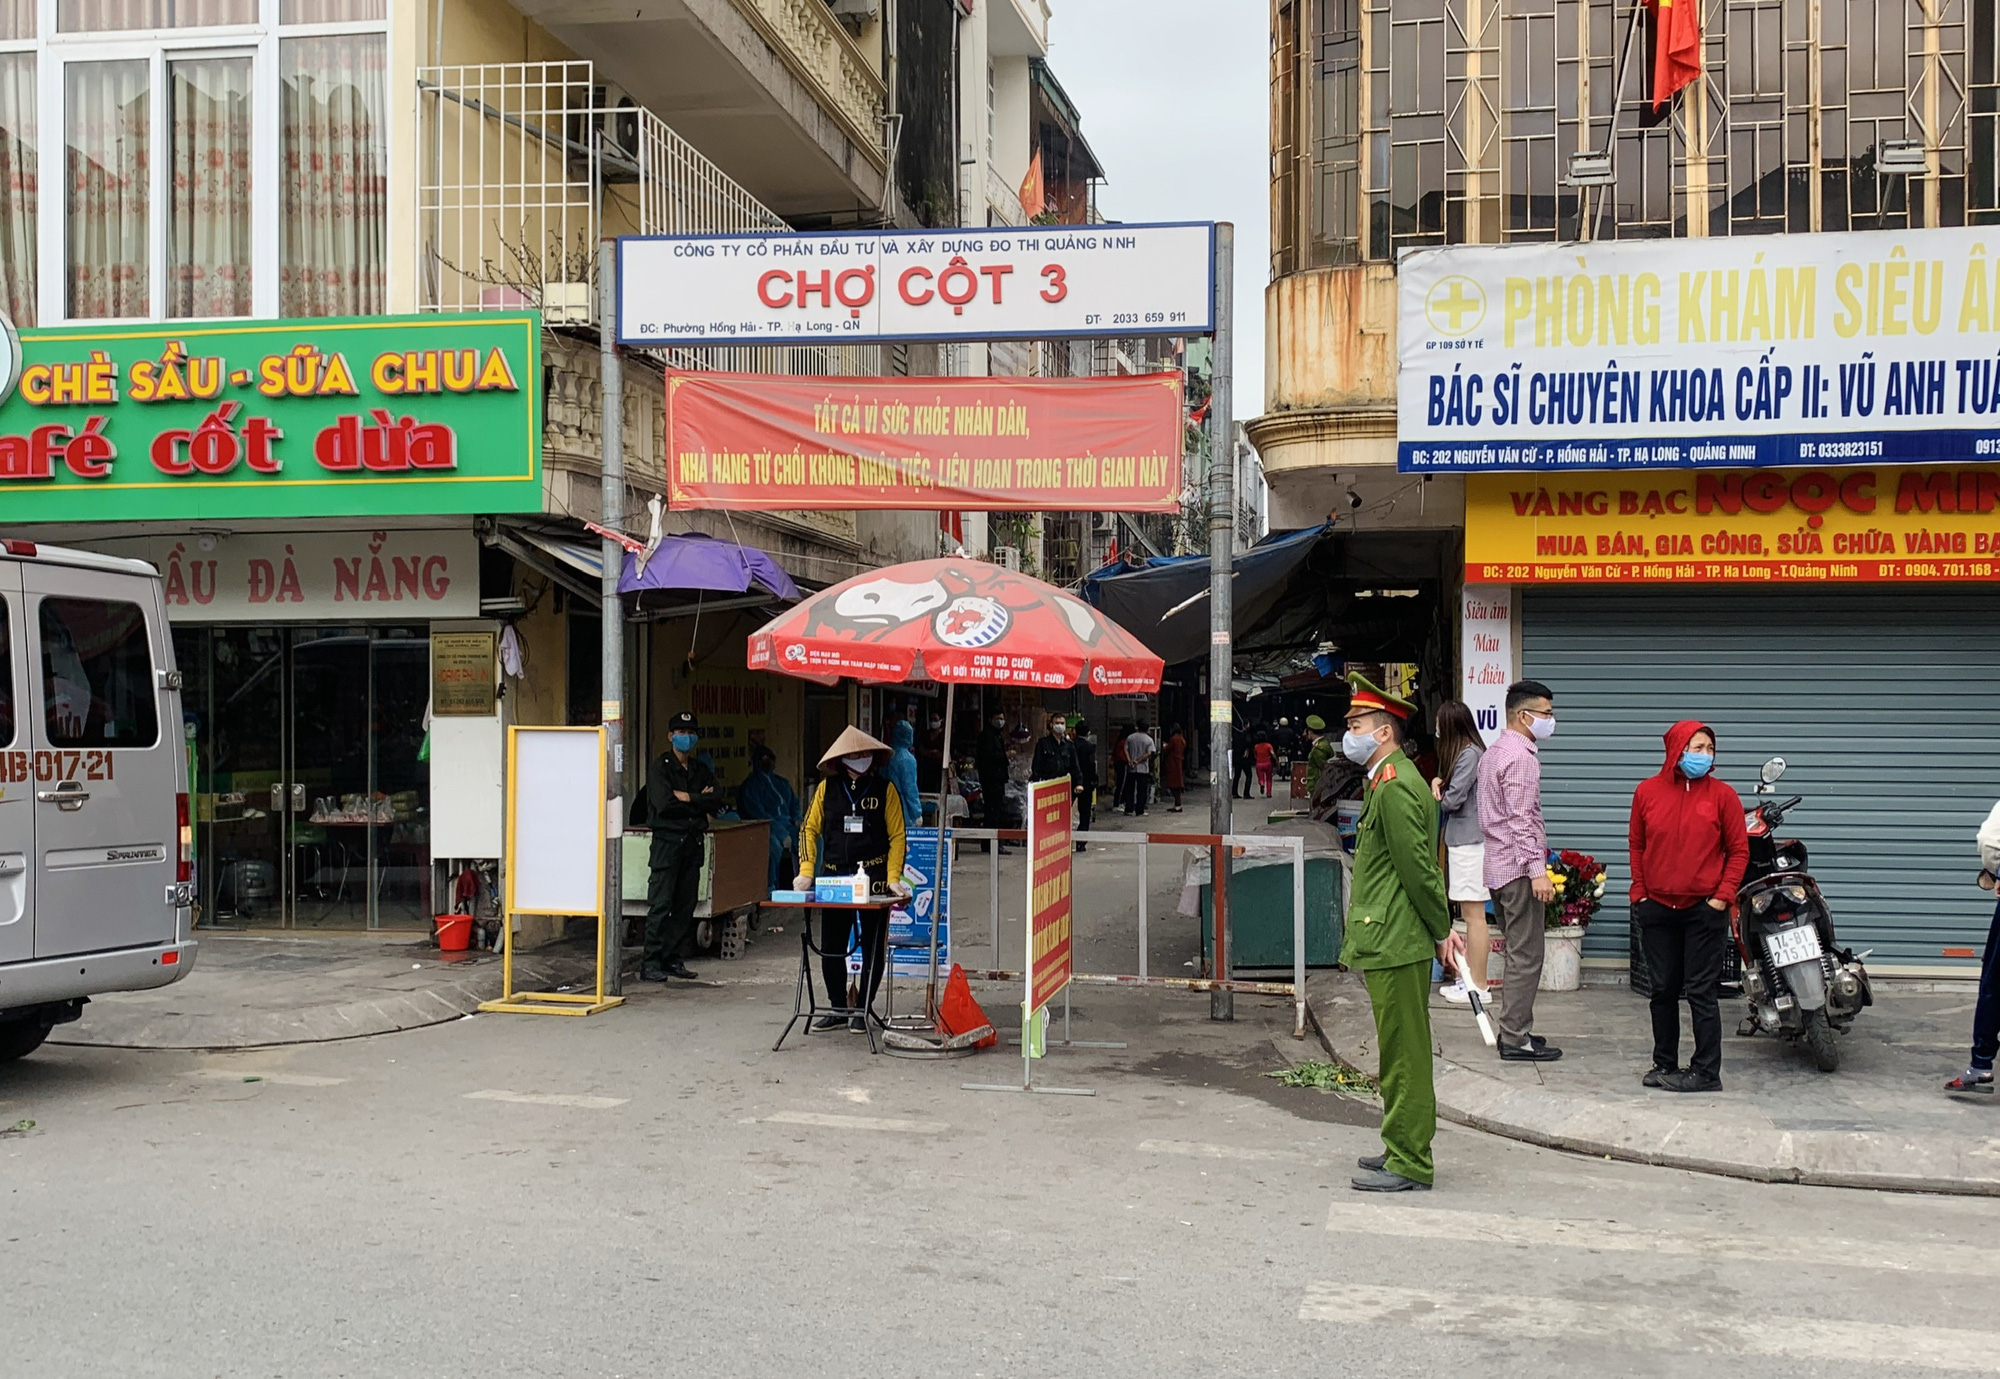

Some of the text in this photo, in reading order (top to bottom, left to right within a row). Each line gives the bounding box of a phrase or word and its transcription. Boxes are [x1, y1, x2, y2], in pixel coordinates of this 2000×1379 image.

[674, 242, 715, 257] CÔNG
[721, 244, 741, 257] TY
[855, 241, 875, 255] TƯ
[882, 238, 899, 254] VÀ
[907, 238, 934, 254] XÂY
[942, 239, 983, 256] DỰNG
[1045, 234, 1097, 251] QUẢNG
[757, 255, 1068, 318] CHỢ CỘT 3
[1503, 242, 2000, 348] PHÒNG KHÁM SIÊU Â
[640, 323, 659, 334] ĐC:
[663, 320, 705, 336] Phường
[767, 322, 783, 332] TP.
[807, 320, 832, 333] Long
[843, 320, 860, 331] QN
[1113, 313, 1138, 324] 2033
[1145, 312, 1164, 323] 659
[1170, 311, 1186, 322] 911
[1426, 341, 1437, 350] GP
[1439, 340, 1453, 349] 109
[1467, 340, 1472, 349] Y
[20, 340, 519, 405] CHÈ SẦU SỮA CHUA
[1427, 362, 1483, 426] BÁC
[1491, 362, 1522, 425] SĨ
[1529, 359, 1641, 425] CHUYÊN
[1649, 367, 1725, 422] KHOA
[1735, 346, 1792, 421] CẤP
[1801, 365, 1829, 418] II:
[1839, 352, 1876, 417] VŨ
[1883, 360, 1946, 416] ANH
[814, 393, 1030, 440] TẤT CẢ VÌ SỨC KHỎE NHÂN DÂN,
[150, 400, 283, 474] cốt
[314, 408, 457, 472] dừa
[1412, 449, 1430, 465] ĐC:
[1432, 449, 1451, 464] 202
[1454, 444, 1495, 464] NGUYỄN
[1498, 446, 1519, 463] VĂN
[1546, 449, 1554, 464] P.
[1589, 443, 1607, 462] HẢI
[1617, 447, 1632, 462] TP.
[1635, 447, 1649, 465] HẠ
[1651, 446, 1680, 461] LONG
[1689, 441, 1726, 462] QUẢNG
[1729, 445, 1756, 460] NINH
[1799, 443, 1816, 458] ĐT:
[1818, 441, 1883, 457] 0333823151
[679, 443, 1169, 493] NHÀ HÀNG TỪ CHỐI KHÔNG NHẬN TIỆC, LIÊN HOAN TRONG THỜI GIAN NÀY
[1509, 487, 1608, 517] VÀNG
[1618, 489, 1688, 519] BẠC
[1696, 471, 1877, 529] NGỌC
[1536, 535, 1587, 556] MUA
[1596, 530, 1650, 557] BÁN,
[1655, 534, 1693, 556] GIA
[1700, 529, 1769, 557] CÔNG,
[1777, 526, 1823, 556] SỬA
[1833, 527, 1896, 555] CHỮA
[1904, 527, 1967, 554] VÀNG
[163, 531, 451, 605] ẦU ĐÀ NẴNG
[1483, 565, 1503, 578] ĐC:
[1506, 565, 1530, 578] 202
[1535, 563, 1577, 580] Nguyễn
[1581, 564, 1602, 578] Văn
[1632, 565, 1640, 578] P.
[1676, 563, 1694, 578] Hải
[1705, 565, 1721, 577] TP.
[1743, 565, 1770, 579] Long
[1830, 564, 1858, 577] Ninh
[1879, 564, 1901, 577] ĐT:
[1464, 600, 1508, 620] Siêu âm
[1473, 633, 1500, 652] Màu
[974, 655, 1033, 669] CON BÒ CƯỜI
[941, 664, 951, 676] VÌ
[1013, 670, 1028, 681] KHI
[1031, 671, 1041, 682] TA
[1044, 672, 1065, 684] CƯỜI
[1468, 666, 1475, 684] 4
[1477, 704, 1498, 731] VŨ
[1774, 929, 1809, 950] 14-B1
[1774, 942, 1816, 964] 215.17
